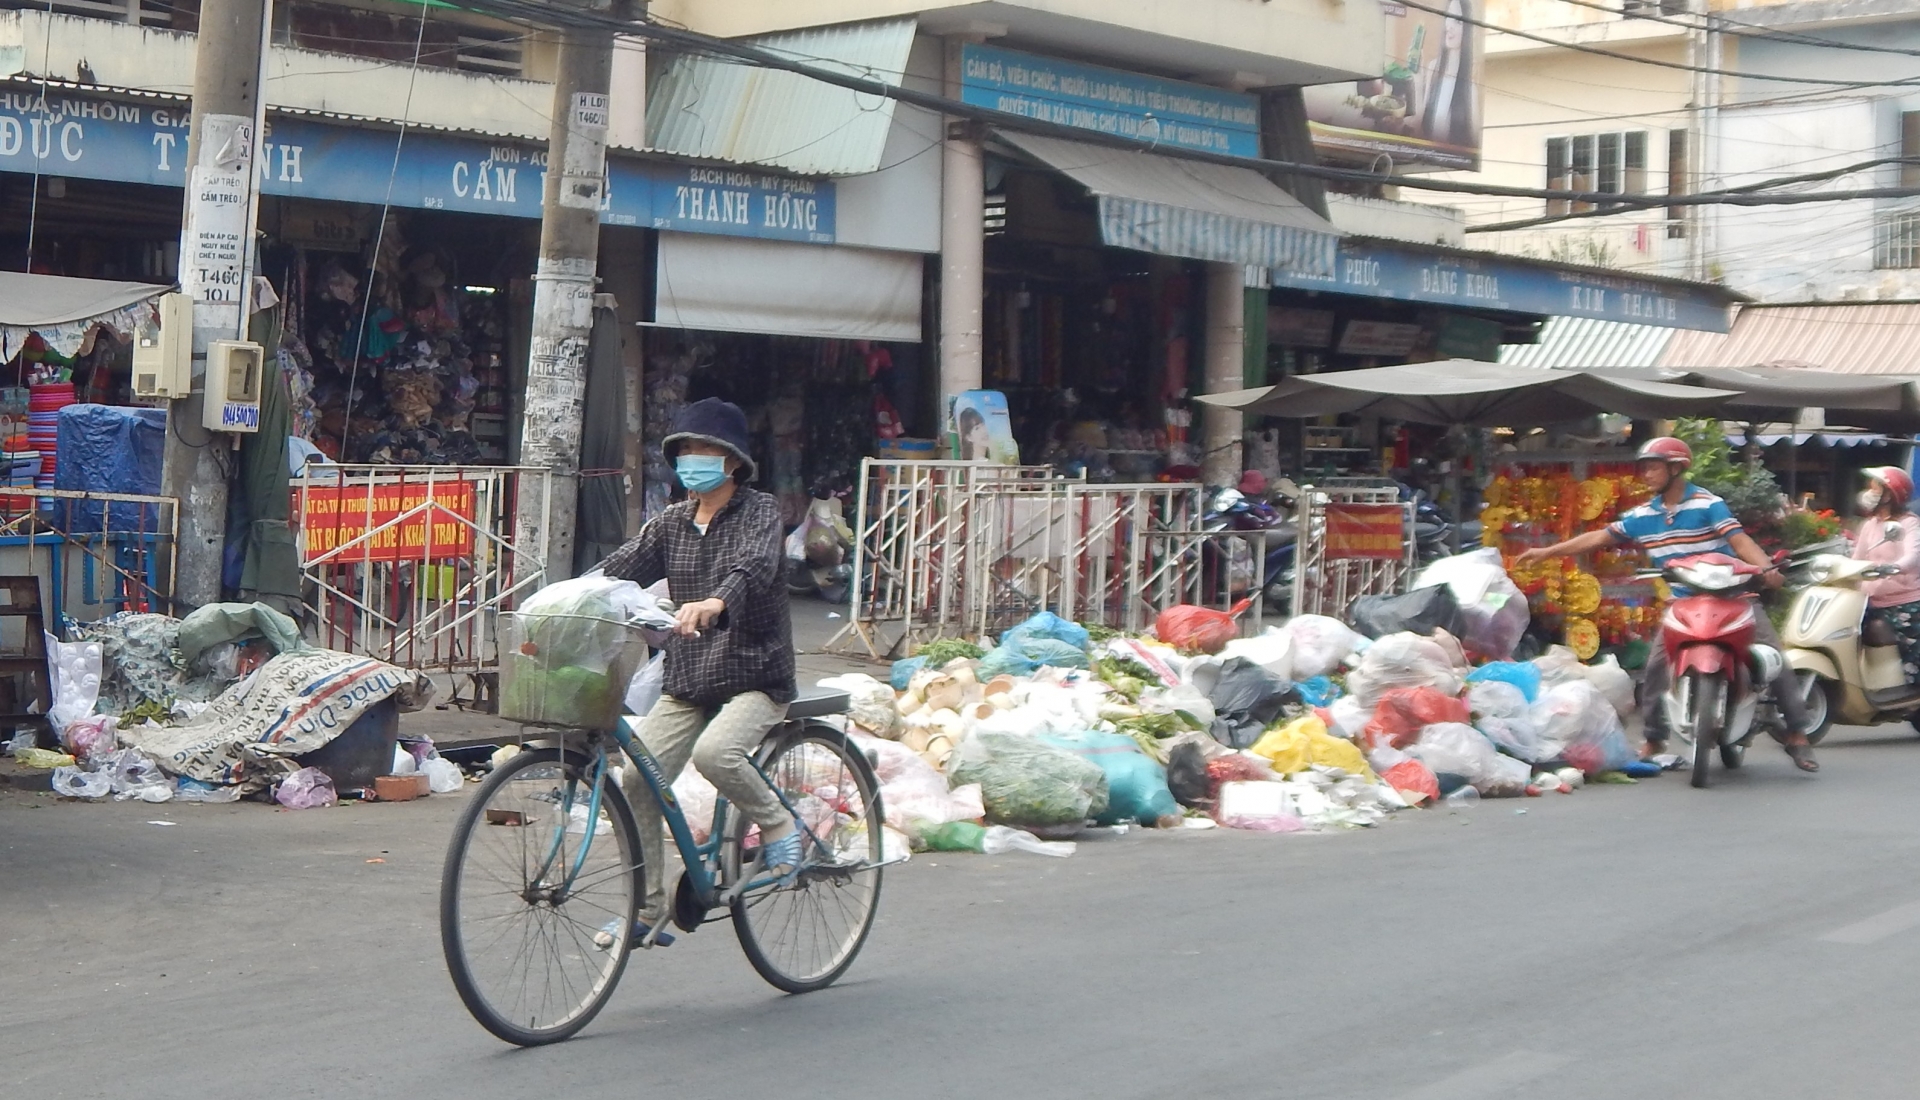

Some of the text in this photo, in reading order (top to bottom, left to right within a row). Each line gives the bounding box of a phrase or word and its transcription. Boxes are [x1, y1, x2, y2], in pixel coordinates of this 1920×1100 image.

[676, 185, 750, 225] THANH
[1466, 273, 1500, 300] KHOA
[1571, 286, 1606, 312] KIM
